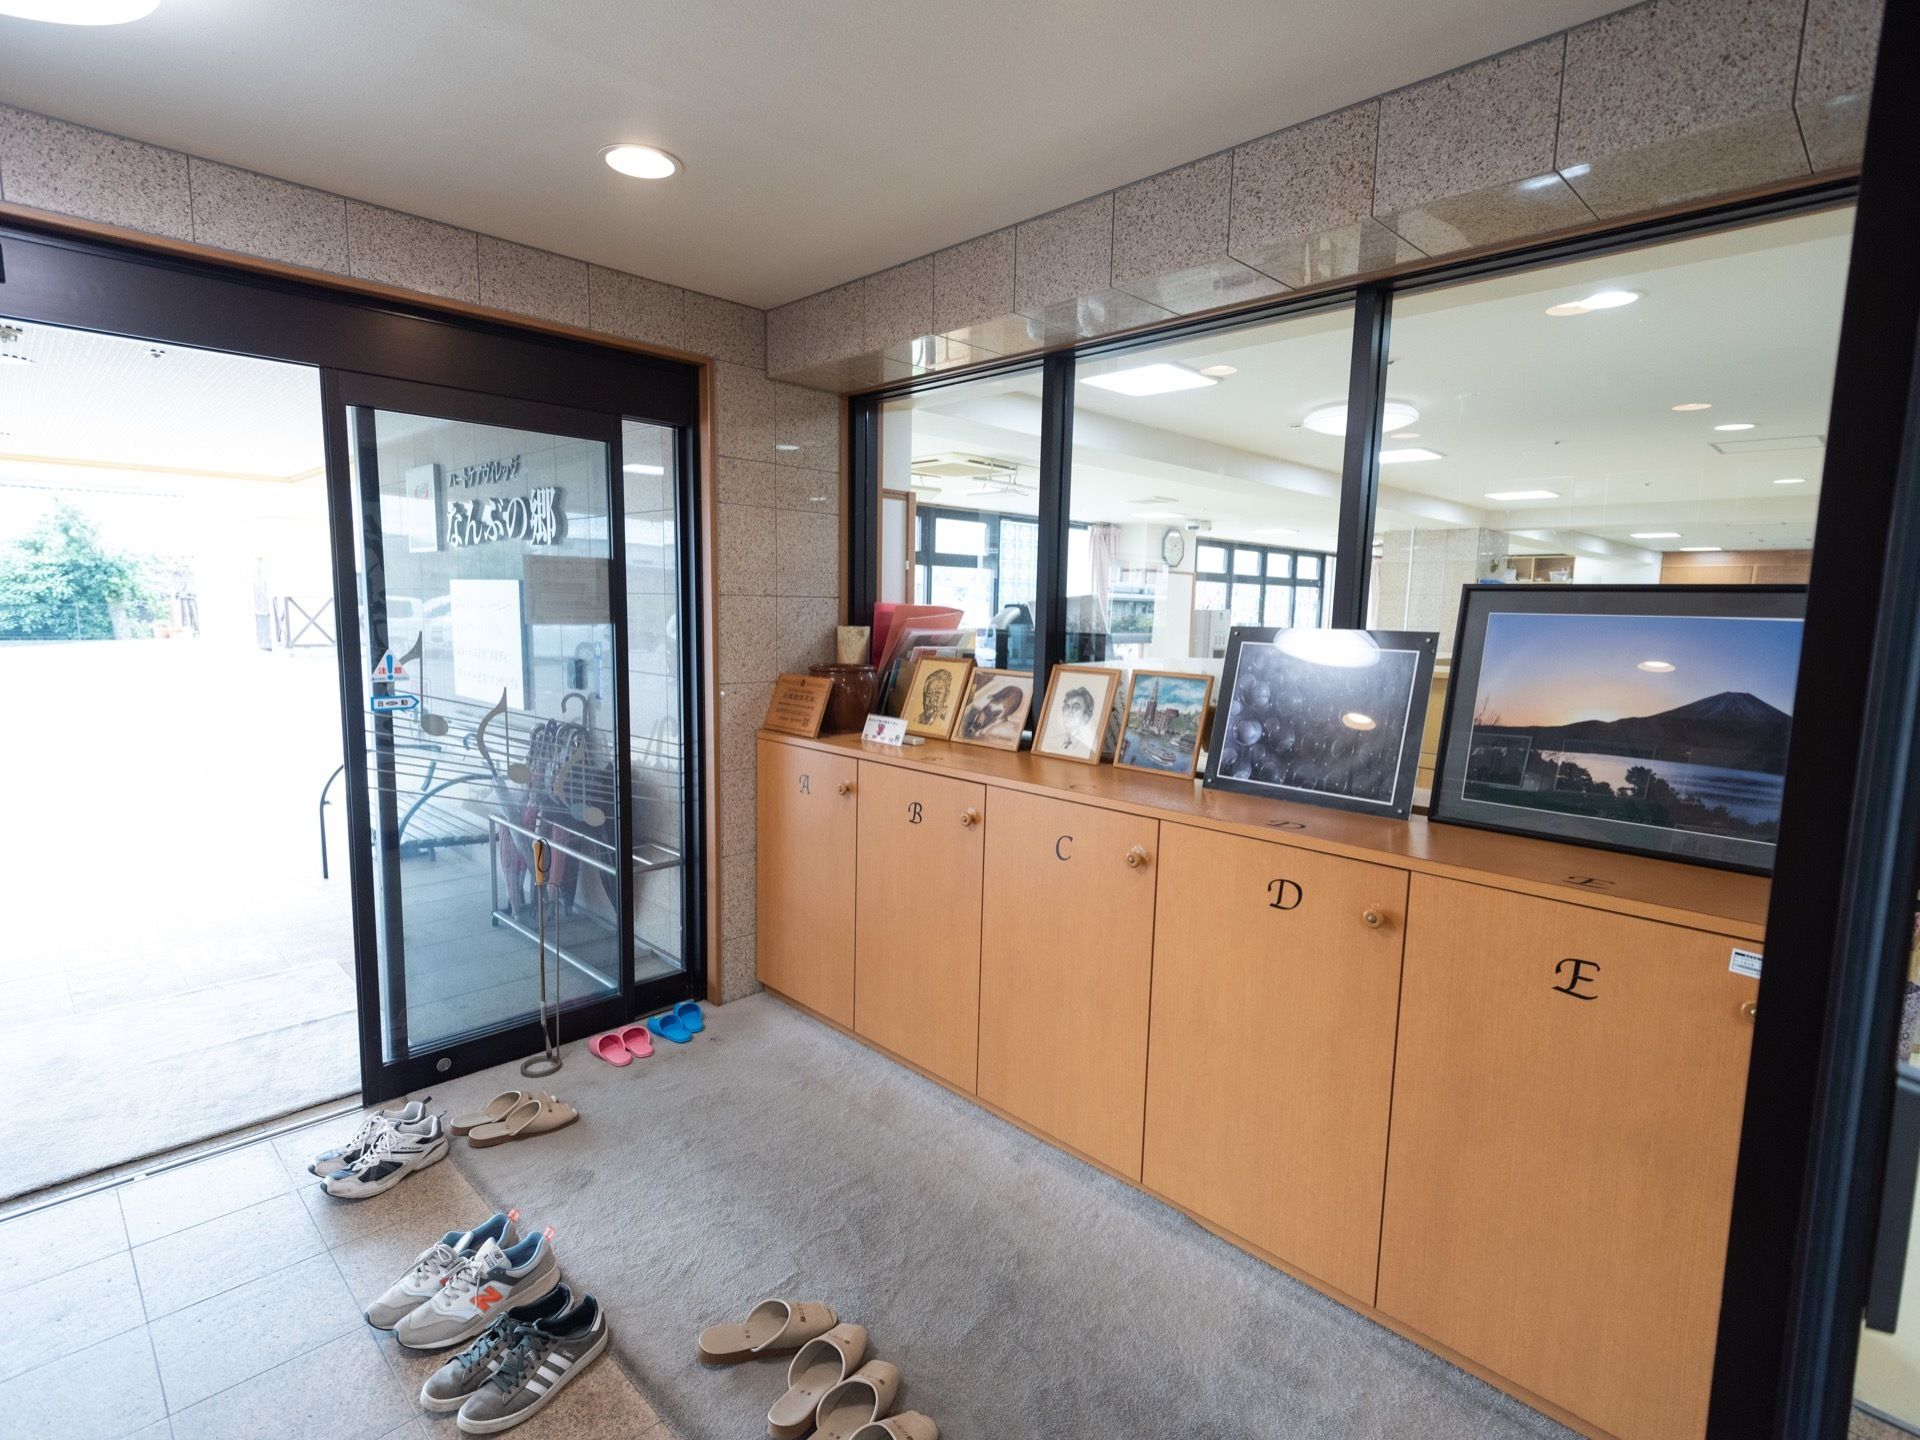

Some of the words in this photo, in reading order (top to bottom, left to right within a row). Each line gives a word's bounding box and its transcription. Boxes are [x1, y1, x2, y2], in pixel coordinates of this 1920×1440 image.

[446, 486, 557, 548] なんぶの郷
[798, 774, 811, 795] A
[907, 801, 923, 825] B
[1055, 835, 1074, 862] C
[1267, 878, 1303, 911] D
[1551, 957, 1601, 1001] E
[469, 1285, 504, 1313] N
